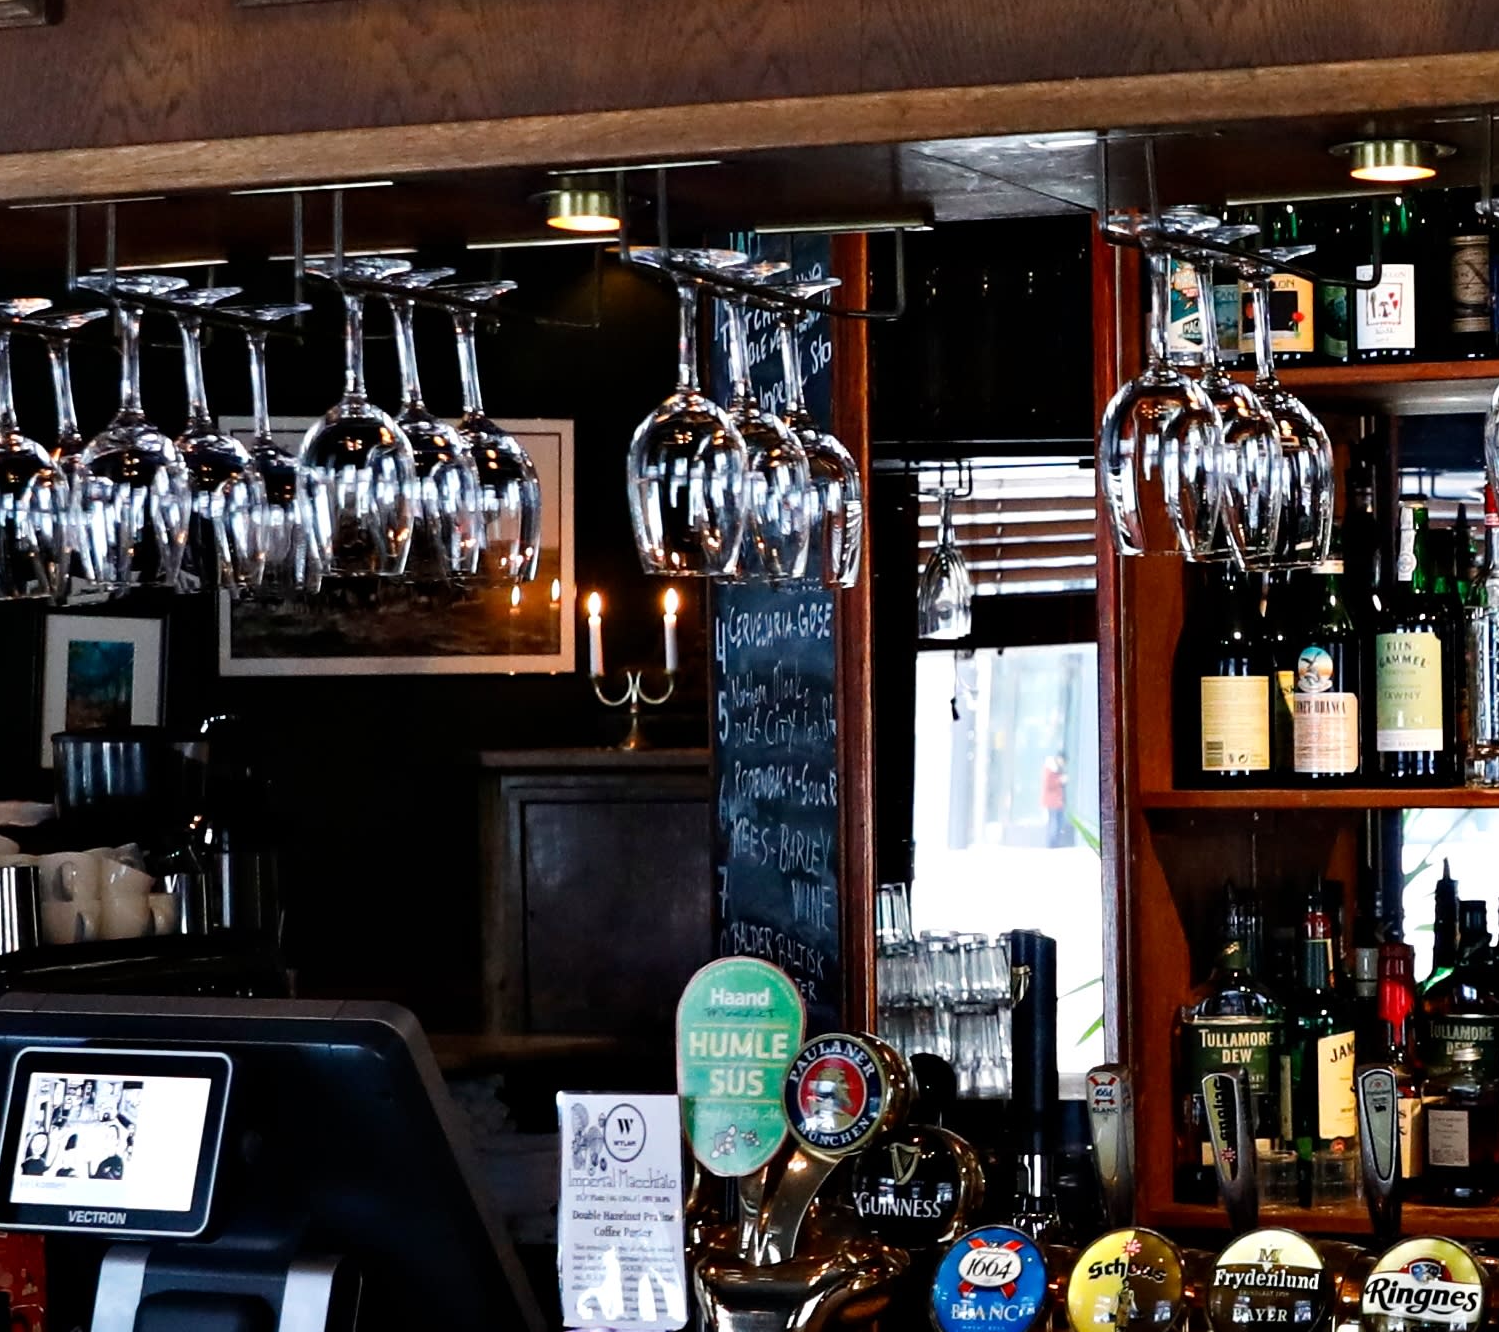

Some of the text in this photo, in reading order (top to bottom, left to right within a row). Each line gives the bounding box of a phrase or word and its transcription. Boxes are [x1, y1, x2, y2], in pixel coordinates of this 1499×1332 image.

[711, 988, 769, 1006] Haand
[690, 1032, 788, 1060] HUMLE
[1199, 1029, 1273, 1048] TULLAMORE
[790, 1040, 874, 1082] PAULANER
[1222, 1049, 1252, 1063] DEW
[861, 1192, 941, 1218] GUINNESS
[68, 1210, 126, 1225] VECTRON
[967, 1259, 1013, 1279] 1664
[1214, 1269, 1320, 1291] Frydenlund
[1364, 1278, 1478, 1314] Ringnes
